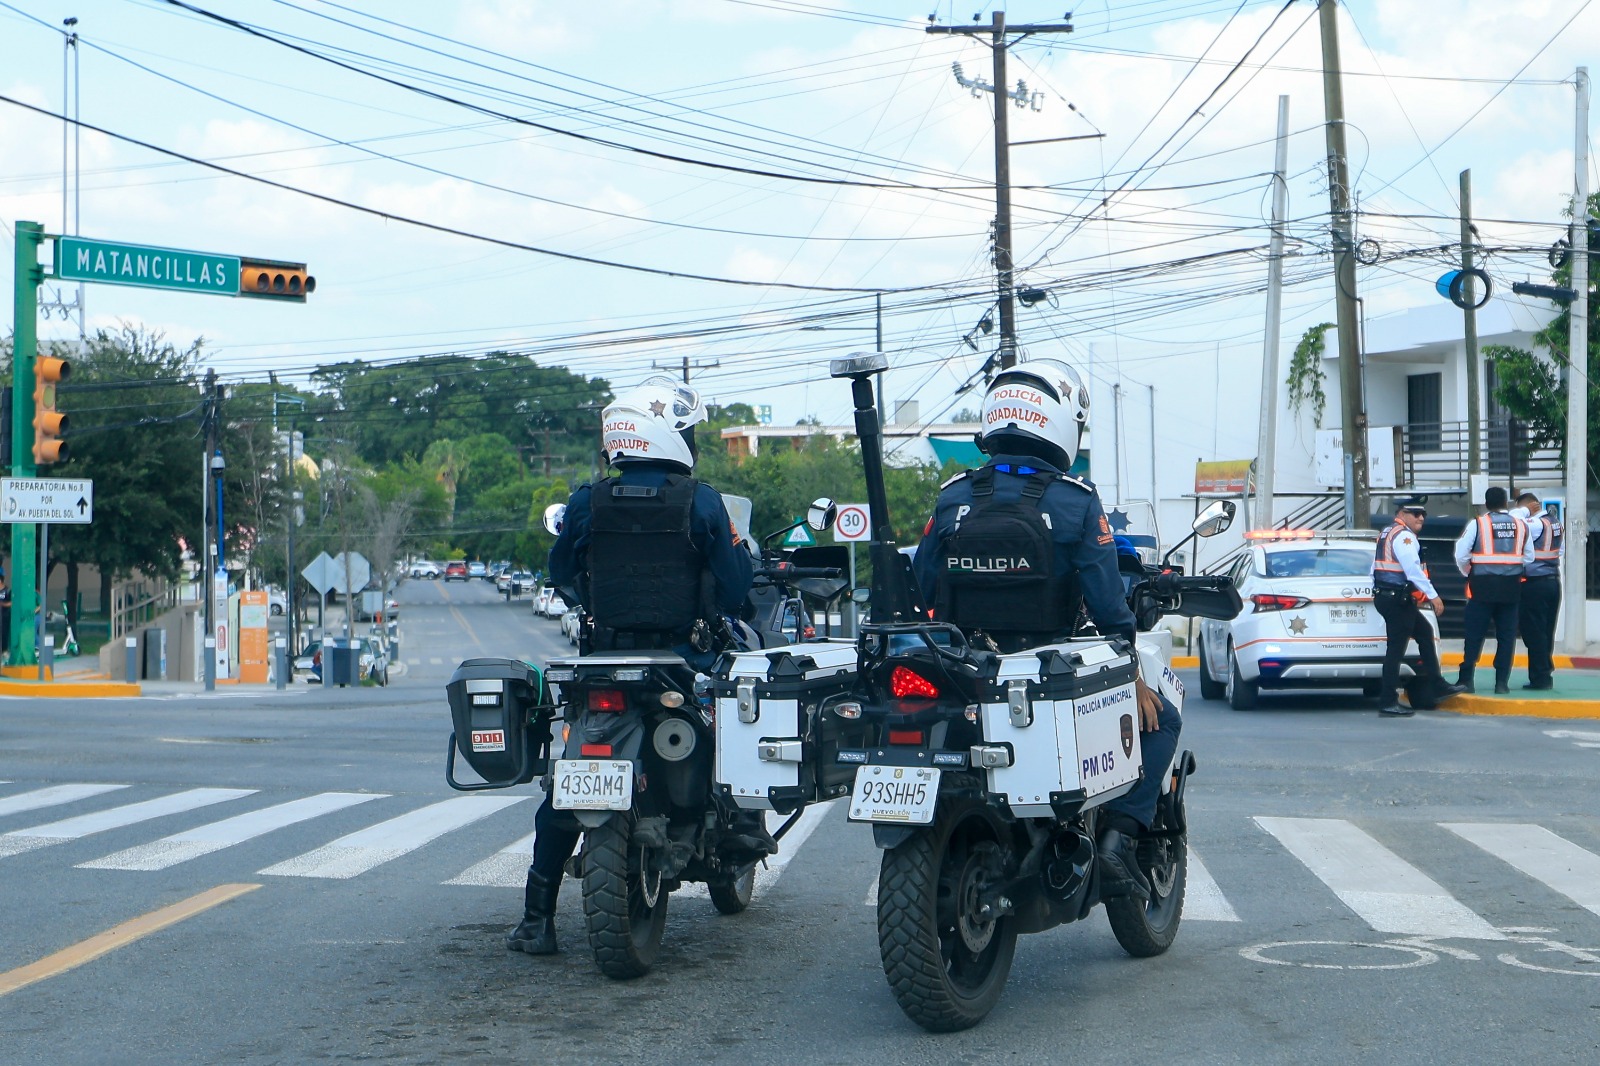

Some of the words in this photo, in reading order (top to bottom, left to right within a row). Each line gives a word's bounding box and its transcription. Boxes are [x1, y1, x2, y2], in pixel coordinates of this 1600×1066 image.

[77, 248, 226, 286] MATANCILLAS
[993, 389, 1043, 406] POLICÍA
[987, 407, 1049, 428] GUADALUPE
[10, 482, 66, 492] PREPARATORIA
[41, 496, 53, 505] POR
[28, 509, 50, 518] PUESTA
[51, 509, 61, 518] DEL
[63, 509, 74, 519] SOL
[844, 514, 860, 527] 30
[947, 557, 1031, 570] POLICIA
[1162, 667, 1175, 686] PM
[1175, 681, 1184, 696] 05
[1077, 697, 1101, 717] POLICÍA
[1102, 688, 1132, 709] MUNICIPAL
[474, 734, 502, 744] 911
[1082, 756, 1100, 780] PM
[1101, 750, 1115, 773] 05
[561, 774, 624, 796] 43SAM4
[862, 781, 927, 805] 93SHH5
